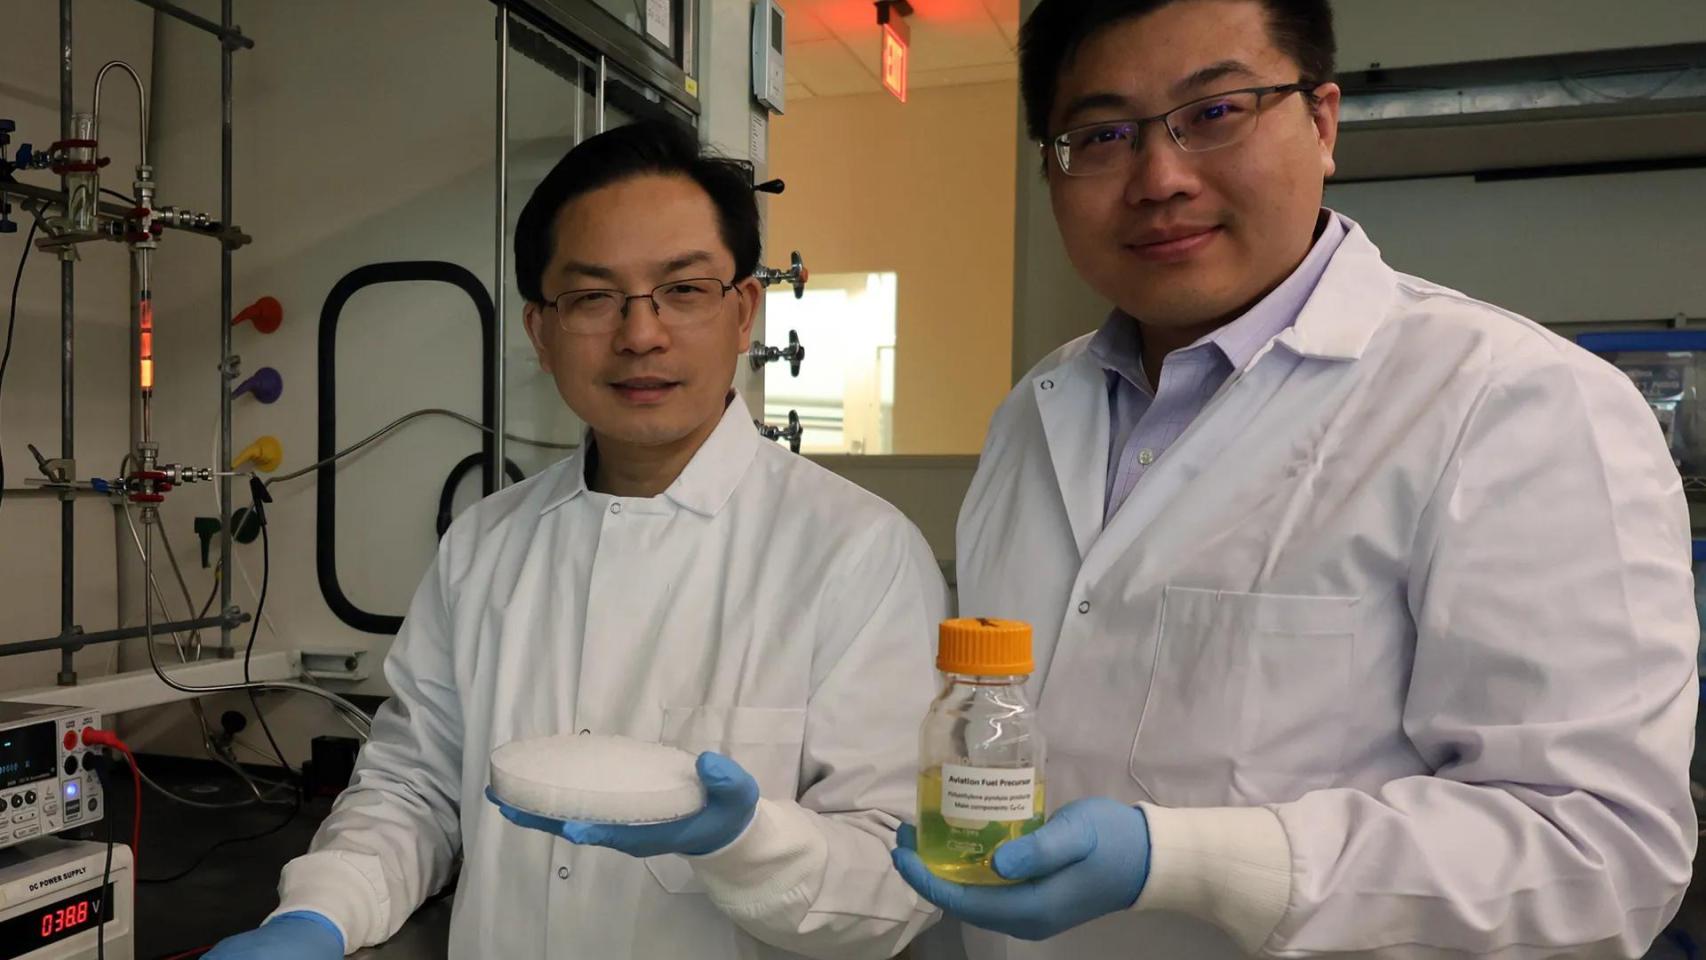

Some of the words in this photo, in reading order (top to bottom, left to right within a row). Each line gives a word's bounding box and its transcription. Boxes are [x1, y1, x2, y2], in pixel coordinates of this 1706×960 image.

[948, 775, 980, 786] Aviation
[981, 778, 998, 786] Fuel
[999, 779, 1031, 787] Precursor
[28, 883, 39, 892] DC
[39, 875, 62, 888] POWER
[63, 867, 86, 880] SUPPLY
[92, 899, 100, 913] V
